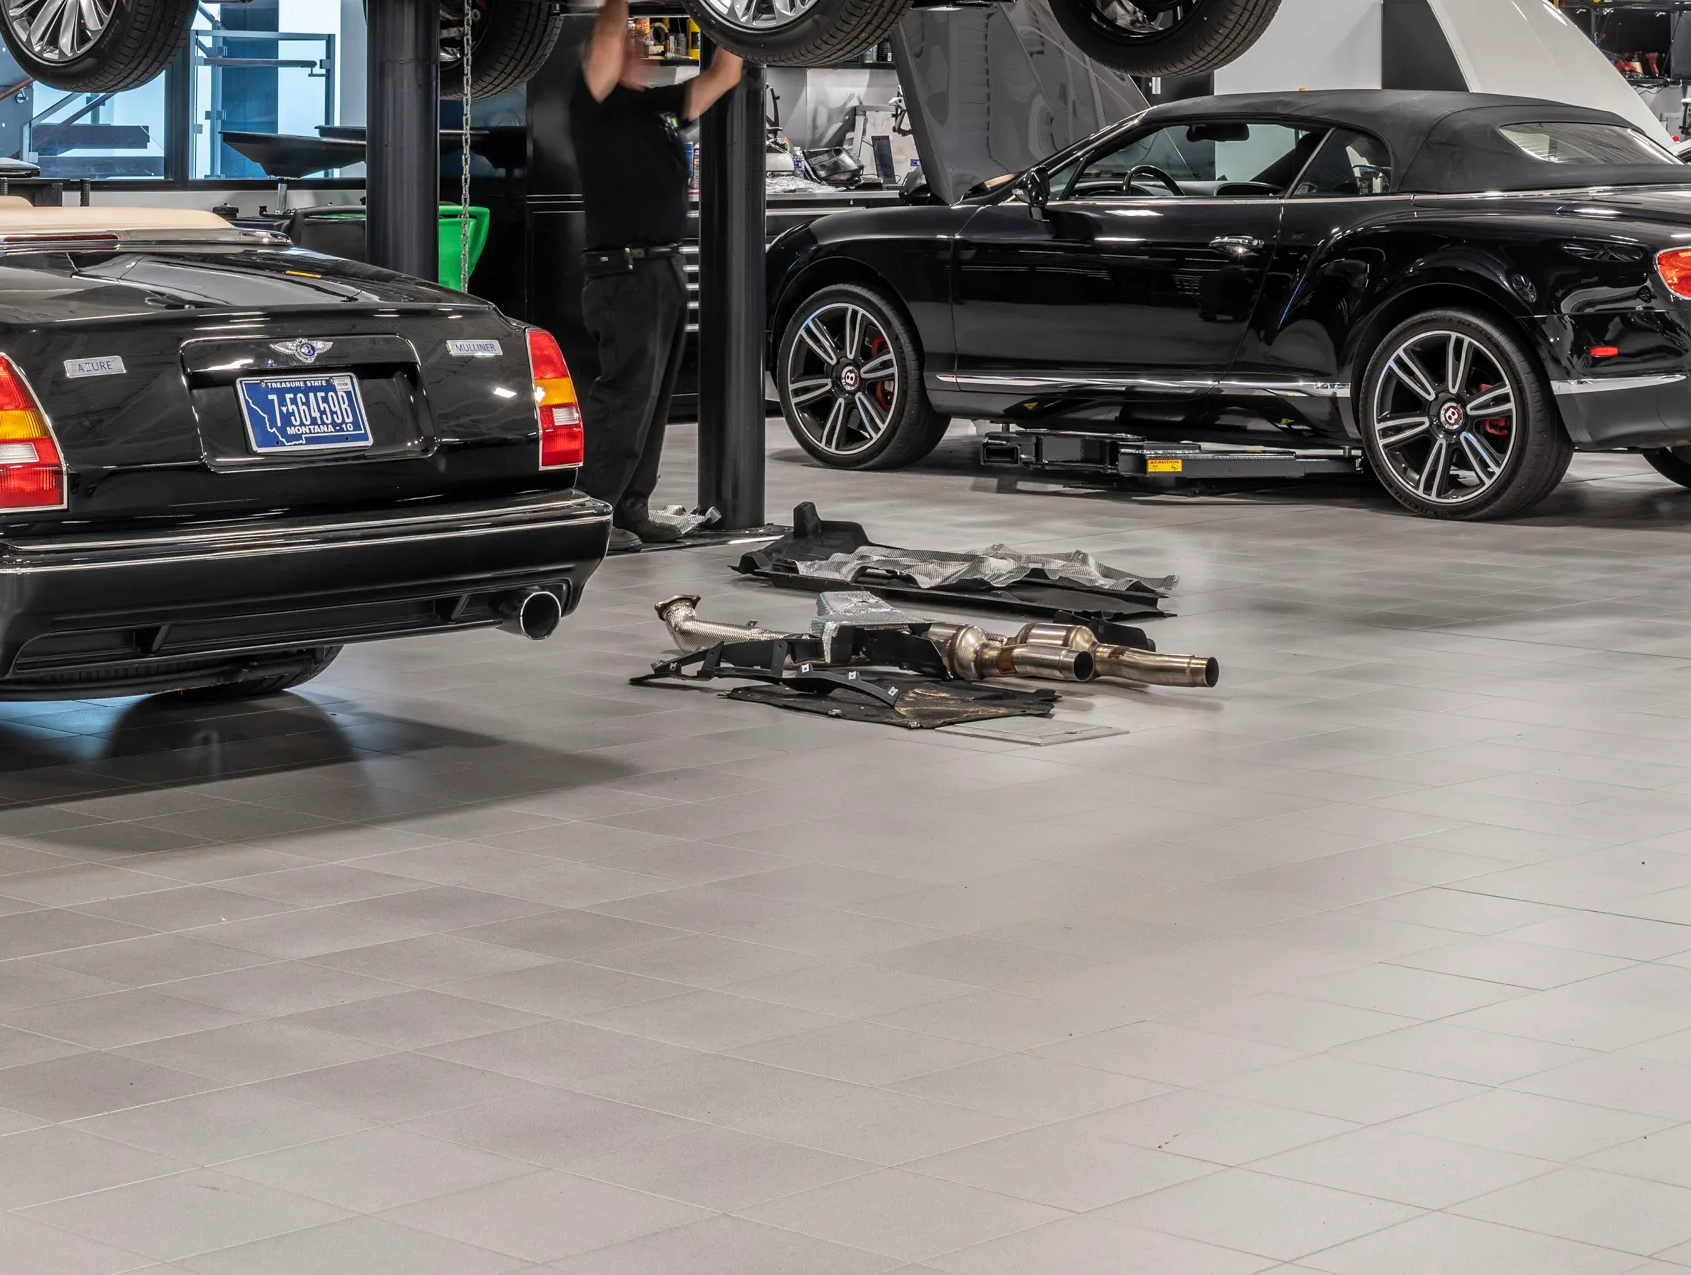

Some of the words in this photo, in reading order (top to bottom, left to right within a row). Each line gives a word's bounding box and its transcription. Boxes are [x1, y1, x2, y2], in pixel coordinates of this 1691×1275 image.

[455, 343, 497, 352] MULLINER
[78, 360, 113, 372] AZURE
[286, 425, 334, 434] MONTANA
[342, 423, 353, 431] 10
